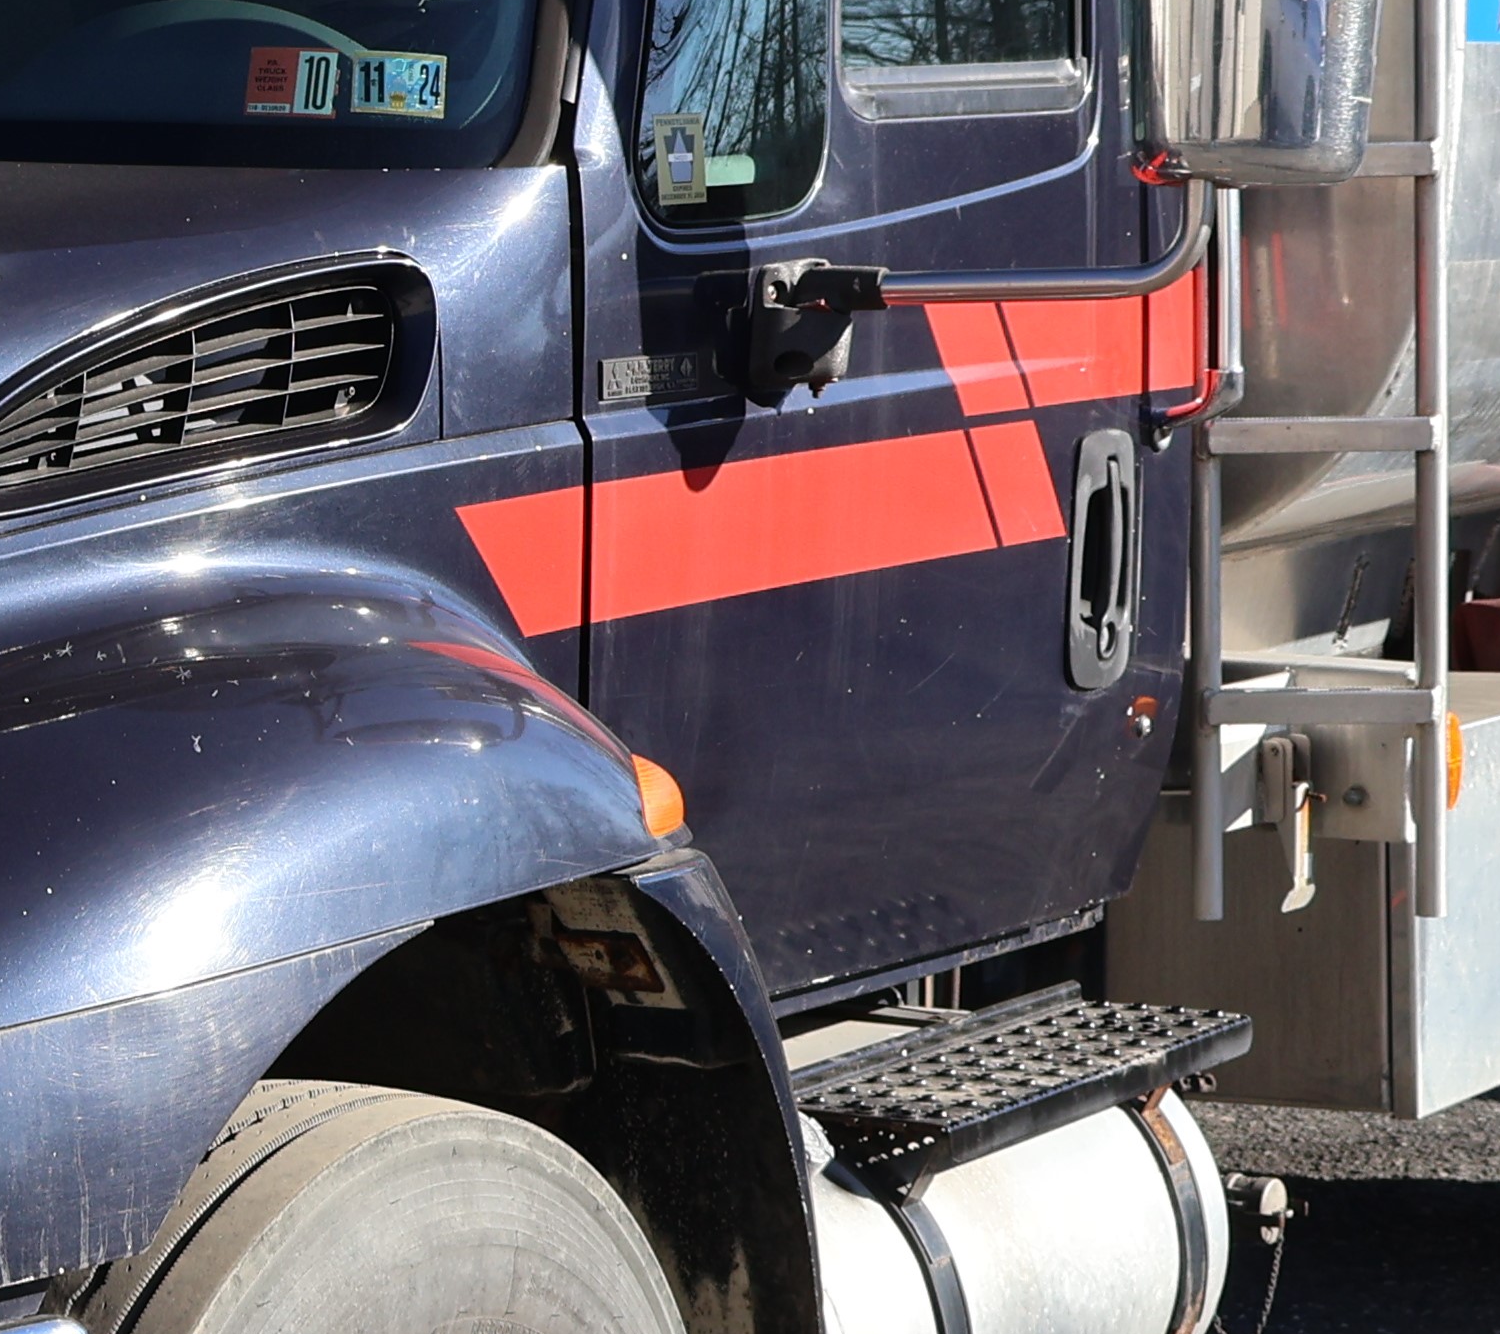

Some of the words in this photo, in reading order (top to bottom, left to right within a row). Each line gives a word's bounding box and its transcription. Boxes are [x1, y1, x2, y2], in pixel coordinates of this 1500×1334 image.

[254, 76, 288, 84] WEIGHT
[258, 67, 287, 75] TRUCK
[304, 55, 331, 111] 10
[359, 60, 385, 103] 11
[256, 84, 285, 92] CLASS
[418, 63, 441, 106] 24
